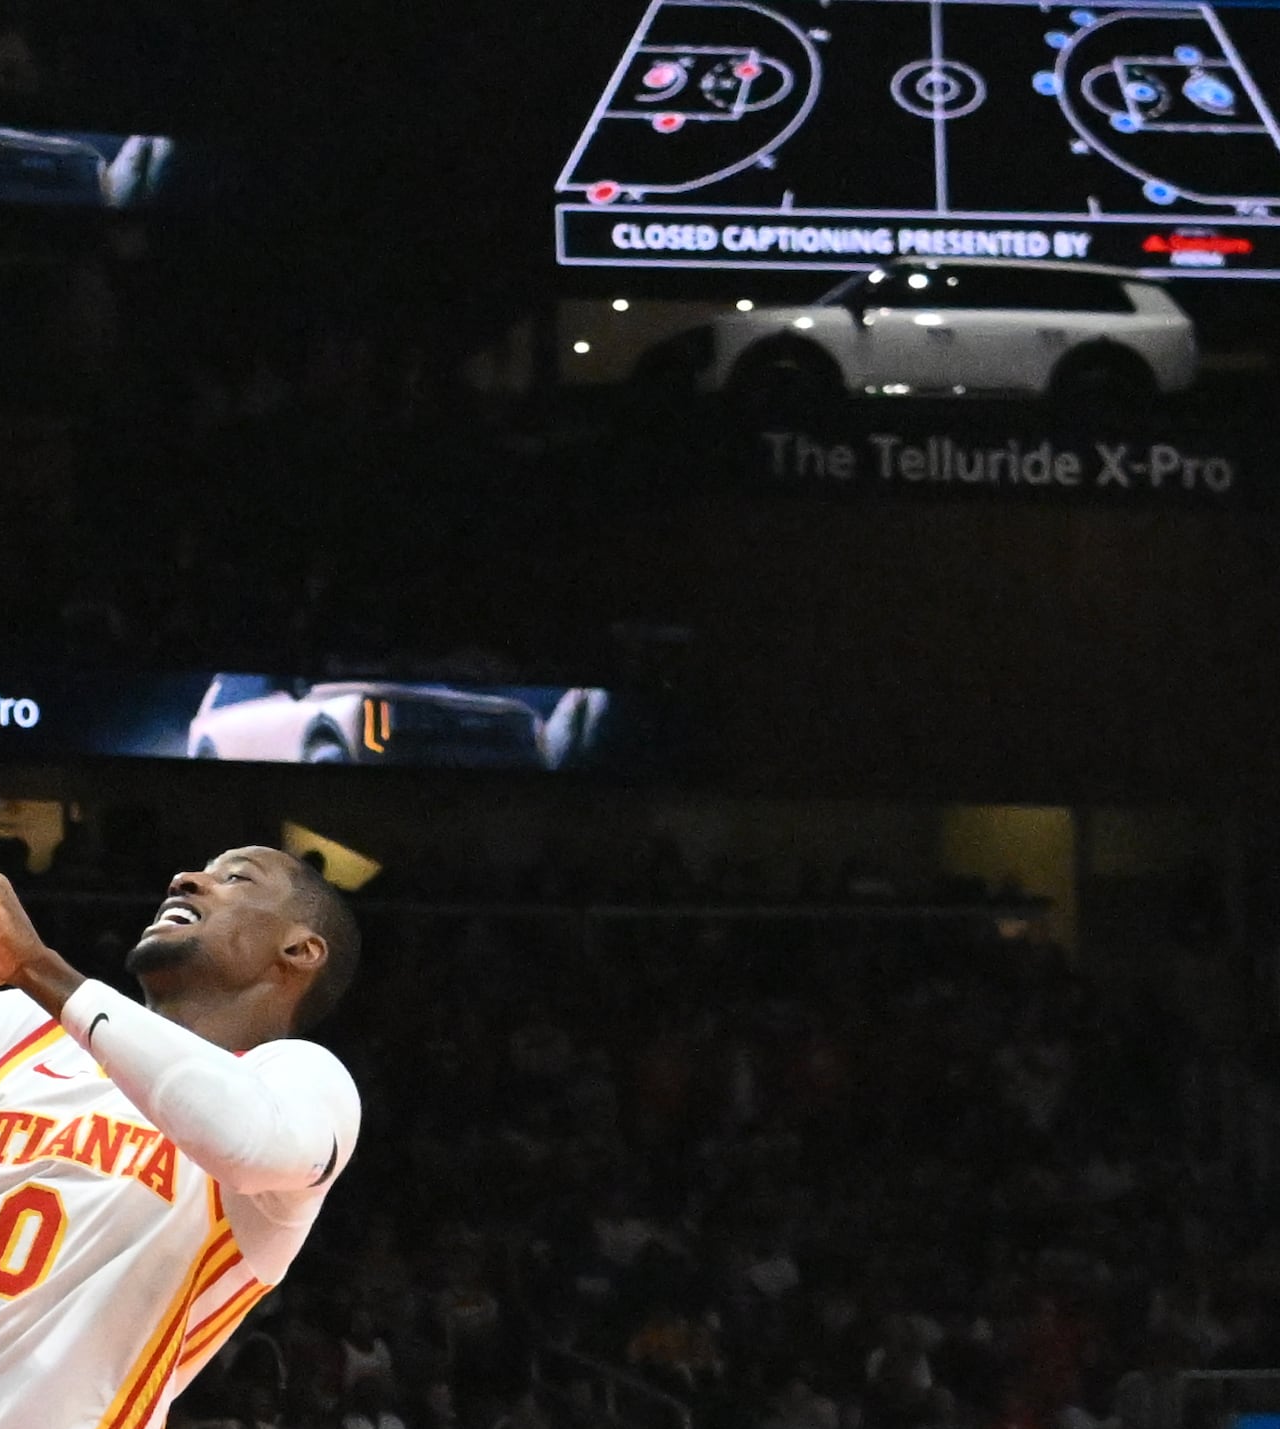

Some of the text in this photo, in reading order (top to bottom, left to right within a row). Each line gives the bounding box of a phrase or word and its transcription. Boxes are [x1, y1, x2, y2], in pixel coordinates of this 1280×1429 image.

[611, 223, 1091, 258] CLOSED CAPTIONING PRESENTED BY
[761, 431, 1234, 493] The Telluride X-Pro
